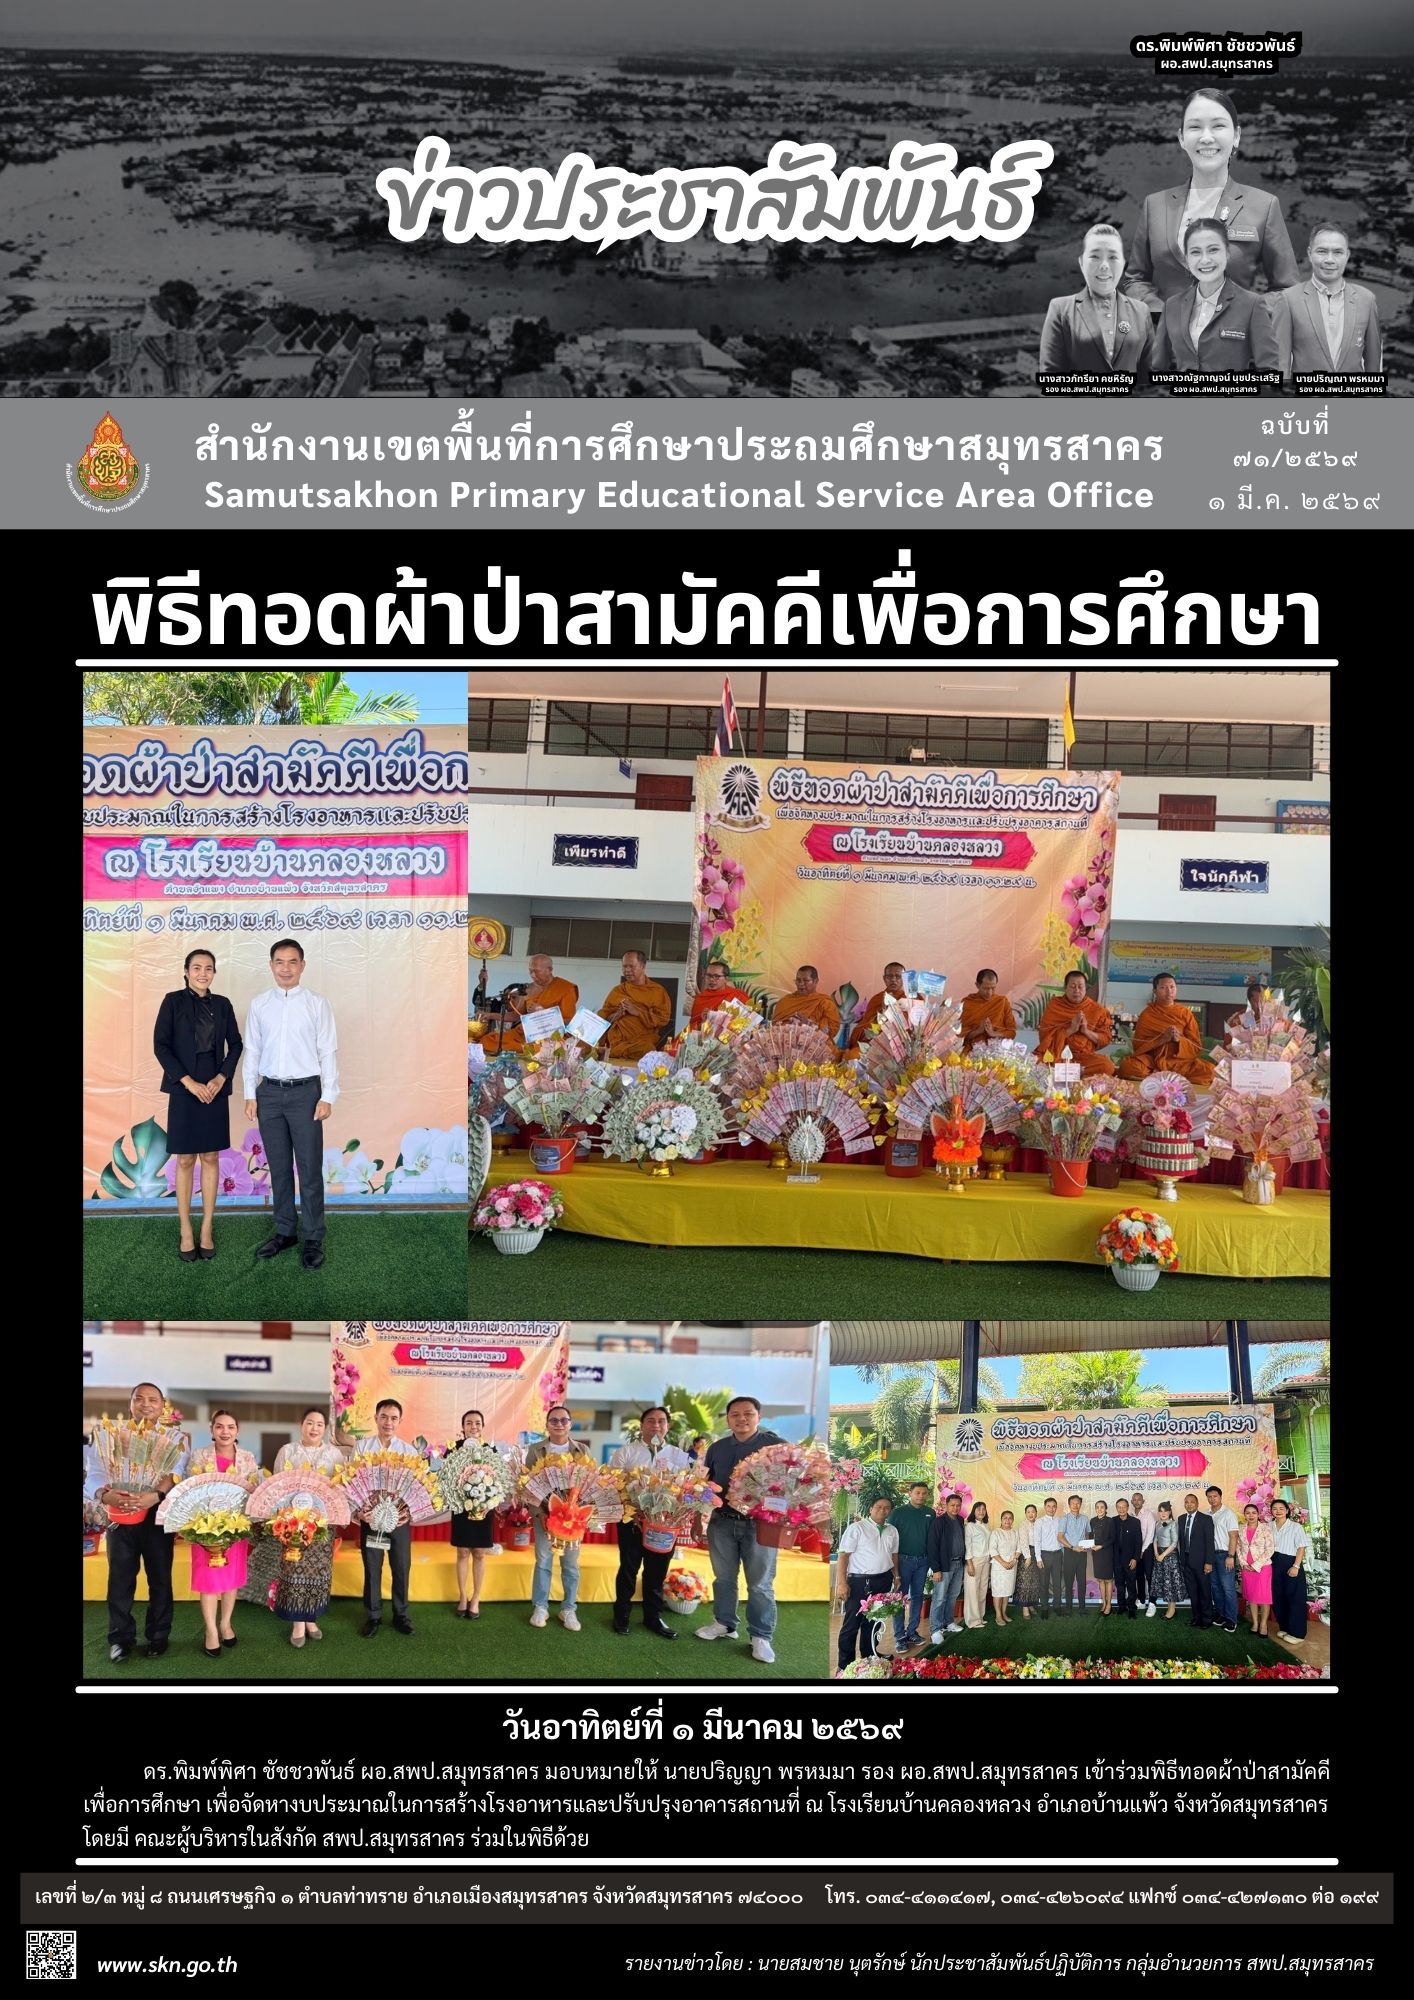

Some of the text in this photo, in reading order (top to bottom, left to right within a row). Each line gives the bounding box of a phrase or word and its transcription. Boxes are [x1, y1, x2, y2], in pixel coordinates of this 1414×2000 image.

[770, 769, 1096, 809] พิธีทอดผ้าป่าสามัคคีเพื่อการศึกษา
[564, 844, 627, 860] เพียรทำดี
[853, 831, 1001, 855] โรงเรียนบ้านคลองหลวง
[108, 842, 443, 875] ณ โรงเรียนบ้านคลองหลวง
[1190, 868, 1260, 884] ใจนักกีฬา
[171, 907, 236, 930] มีนาคม
[241, 911, 284, 930] พ.ศ.
[290, 906, 360, 928] ๒๕๖๙
[367, 910, 413, 929] เวลา
